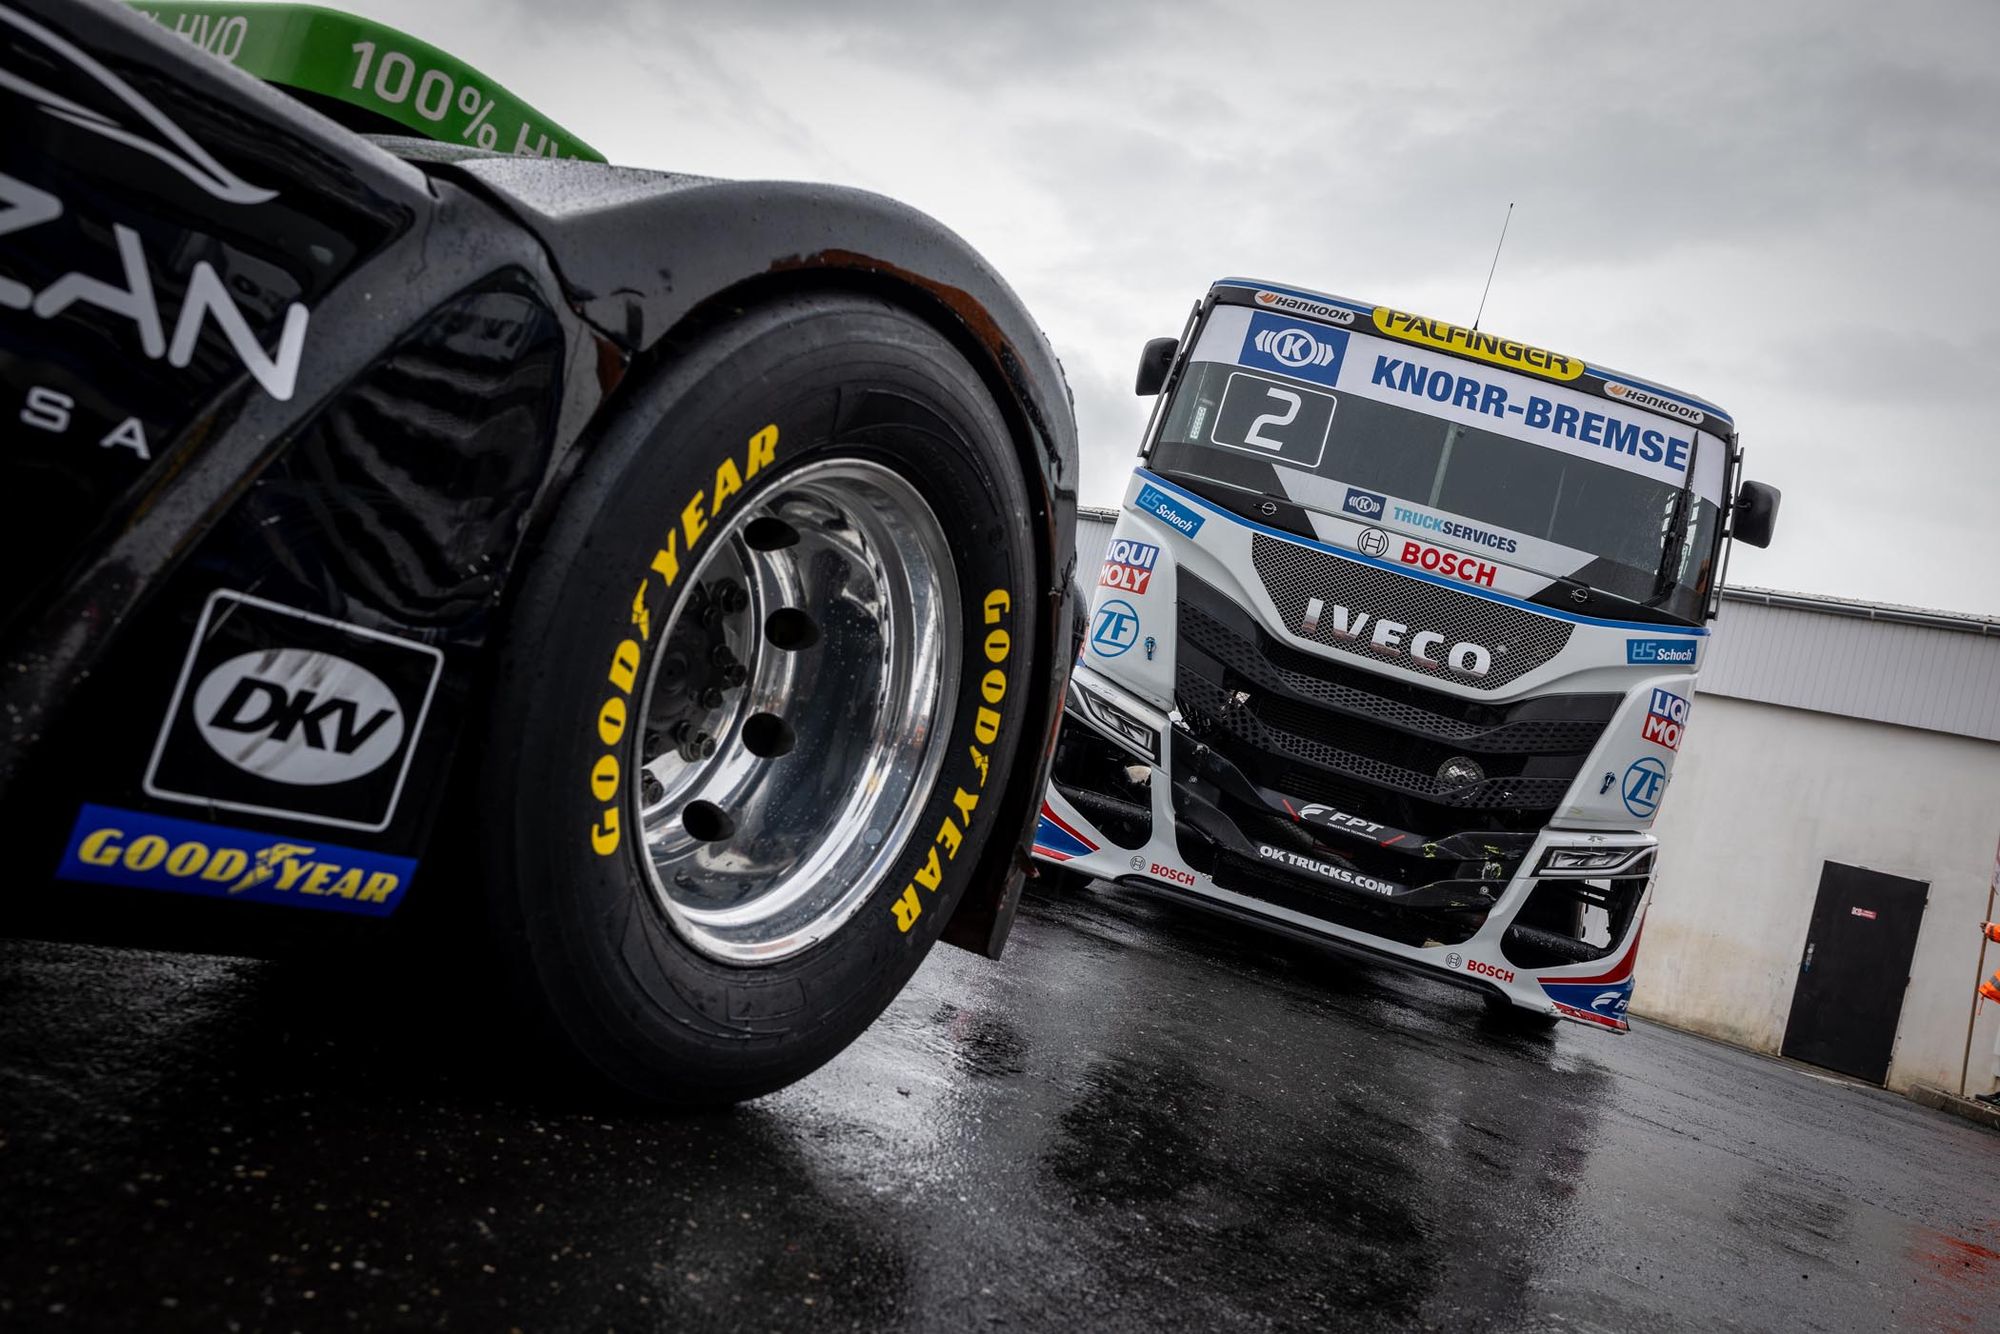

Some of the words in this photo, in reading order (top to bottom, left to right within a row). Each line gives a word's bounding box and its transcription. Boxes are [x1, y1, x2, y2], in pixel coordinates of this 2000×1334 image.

[352, 41, 498, 151] 100%
[1385, 308, 1569, 374] PALFINGER
[1244, 387, 1302, 451] 2
[1371, 355, 1689, 472] KNORR-BREMSE
[1156, 504, 1195, 532] Schoch
[1401, 542, 1497, 587] BOSCH
[591, 424, 779, 856] GOODYEAR
[1093, 608, 1138, 650] ZF
[1302, 597, 1491, 679] IVECO
[1657, 649, 1693, 661] Schoch
[207, 677, 395, 755] DKV
[891, 589, 1011, 933] GOODYEAR
[1626, 763, 1664, 809] ZF
[1329, 812, 1385, 833] FPT
[78, 828, 399, 905] GOODYEAR
[1150, 863, 1195, 886] BOSCH
[1259, 845, 1285, 862] OK
[1288, 853, 1394, 896] TRUCKS.COM
[1467, 959, 1515, 983] BOSCH
